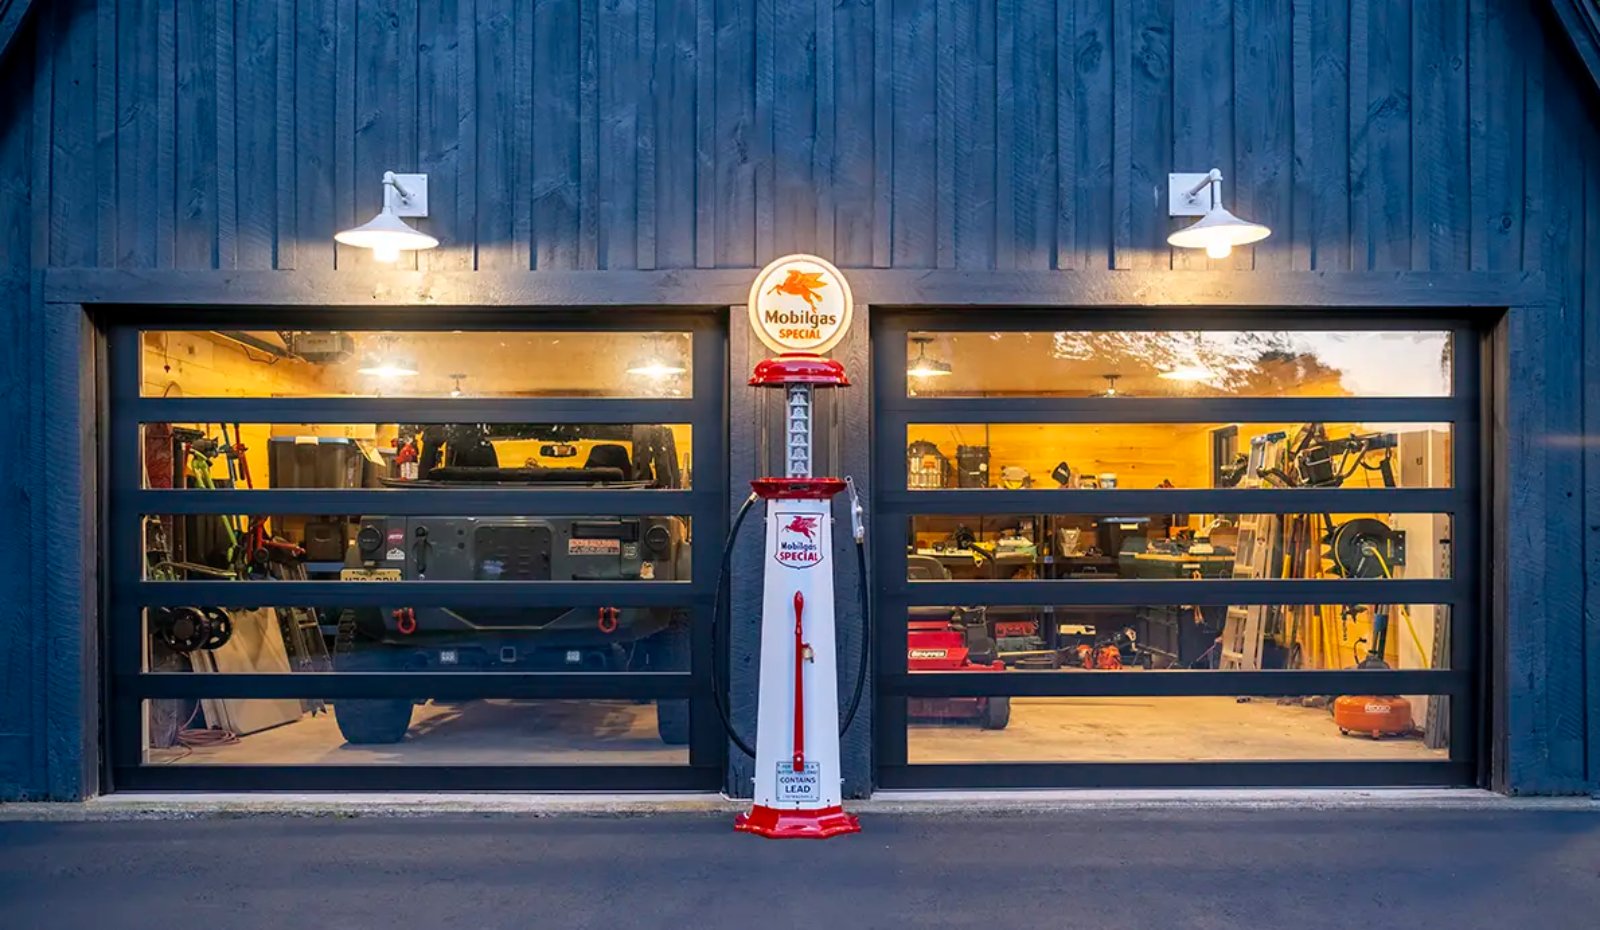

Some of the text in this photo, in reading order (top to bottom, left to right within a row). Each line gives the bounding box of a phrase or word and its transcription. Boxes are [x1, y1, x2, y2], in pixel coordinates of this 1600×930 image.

[765, 310, 836, 328] Mobilgas
[779, 329, 821, 339] SPECIAL
[781, 541, 817, 552] Mobilgas
[780, 552, 818, 561] SPECIAL
[785, 785, 811, 793] LEAD
